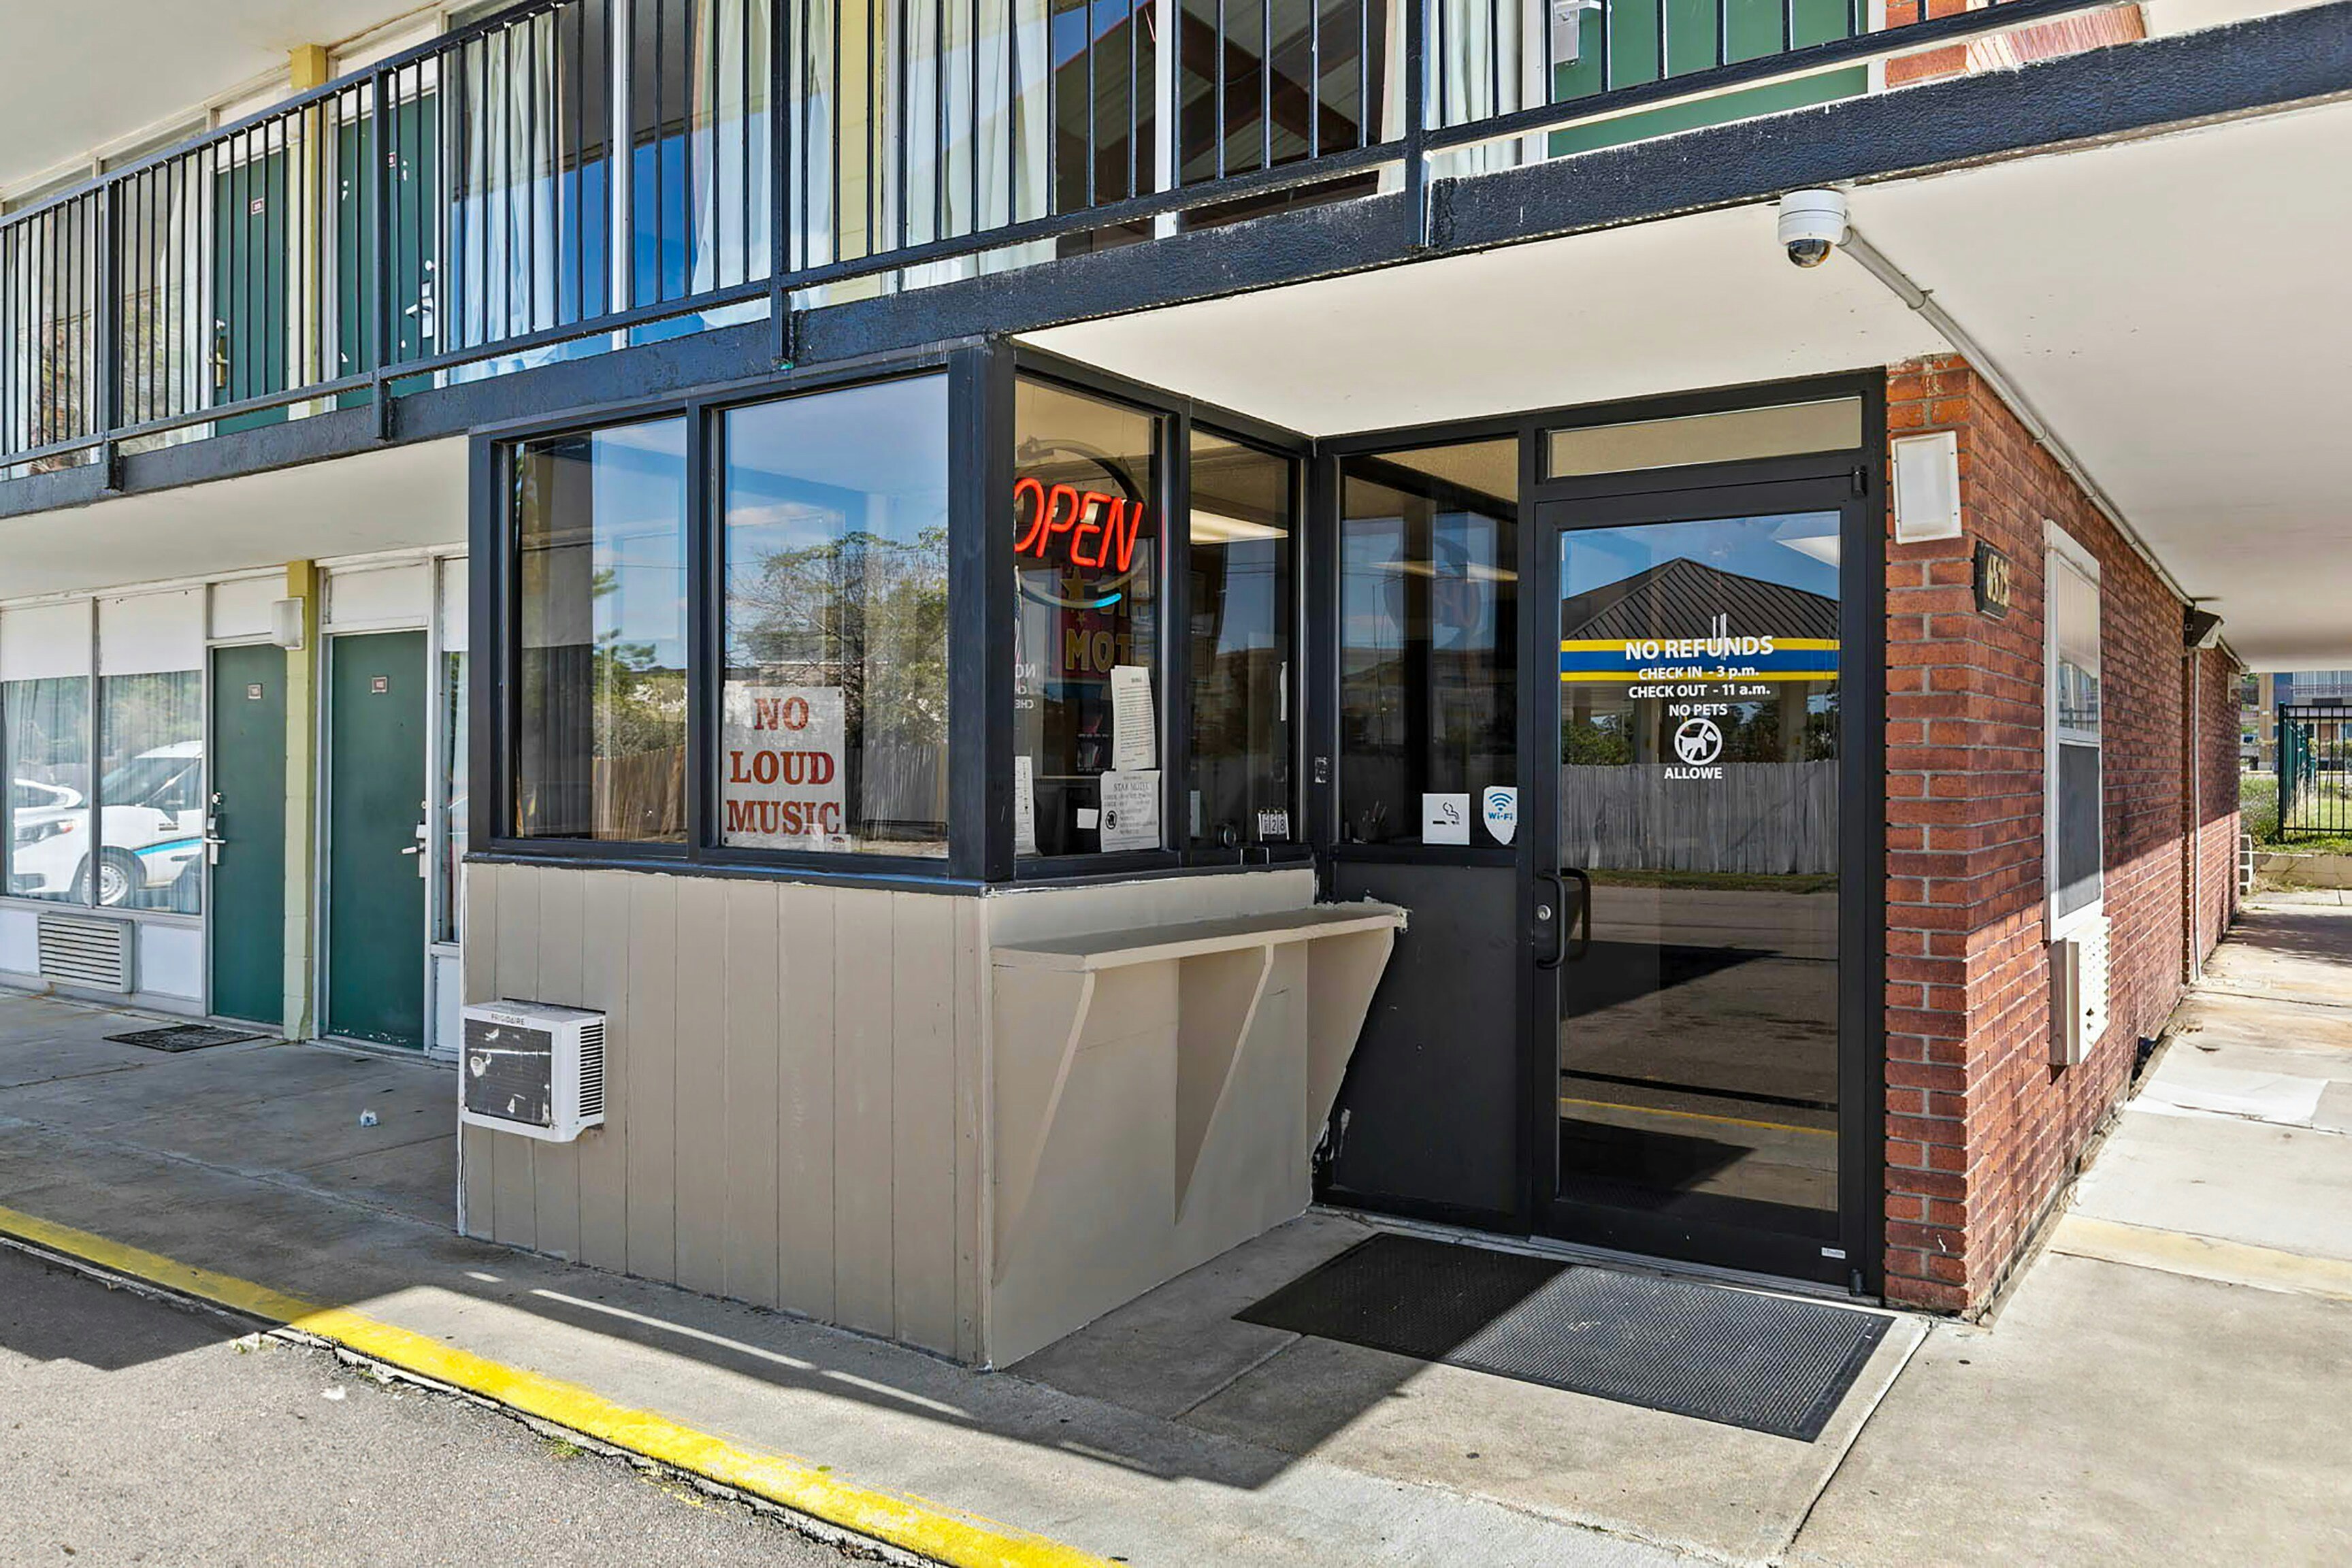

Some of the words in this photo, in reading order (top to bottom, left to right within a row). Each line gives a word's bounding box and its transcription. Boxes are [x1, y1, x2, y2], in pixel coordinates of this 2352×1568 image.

[1014, 477, 1143, 572] OPEN
[1625, 641, 1659, 660] NO
[1665, 635, 1774, 659] REFUNDS
[1638, 668, 1684, 681] CHECK
[1688, 666, 1702, 679] IN
[1717, 666, 1725, 677] 3
[1728, 664, 1760, 679] p.m.
[1628, 685, 1674, 698] CHECK
[1678, 685, 1708, 698] OUT
[1722, 684, 1735, 696] 11
[1740, 683, 1771, 696] a.m.
[753, 697, 809, 732] NO
[1669, 704, 1689, 717] NO
[1693, 704, 1727, 716] PETS
[729, 750, 835, 785] LOUD
[1665, 767, 1722, 780] ALLOWE
[725, 800, 840, 835] MUSIC
